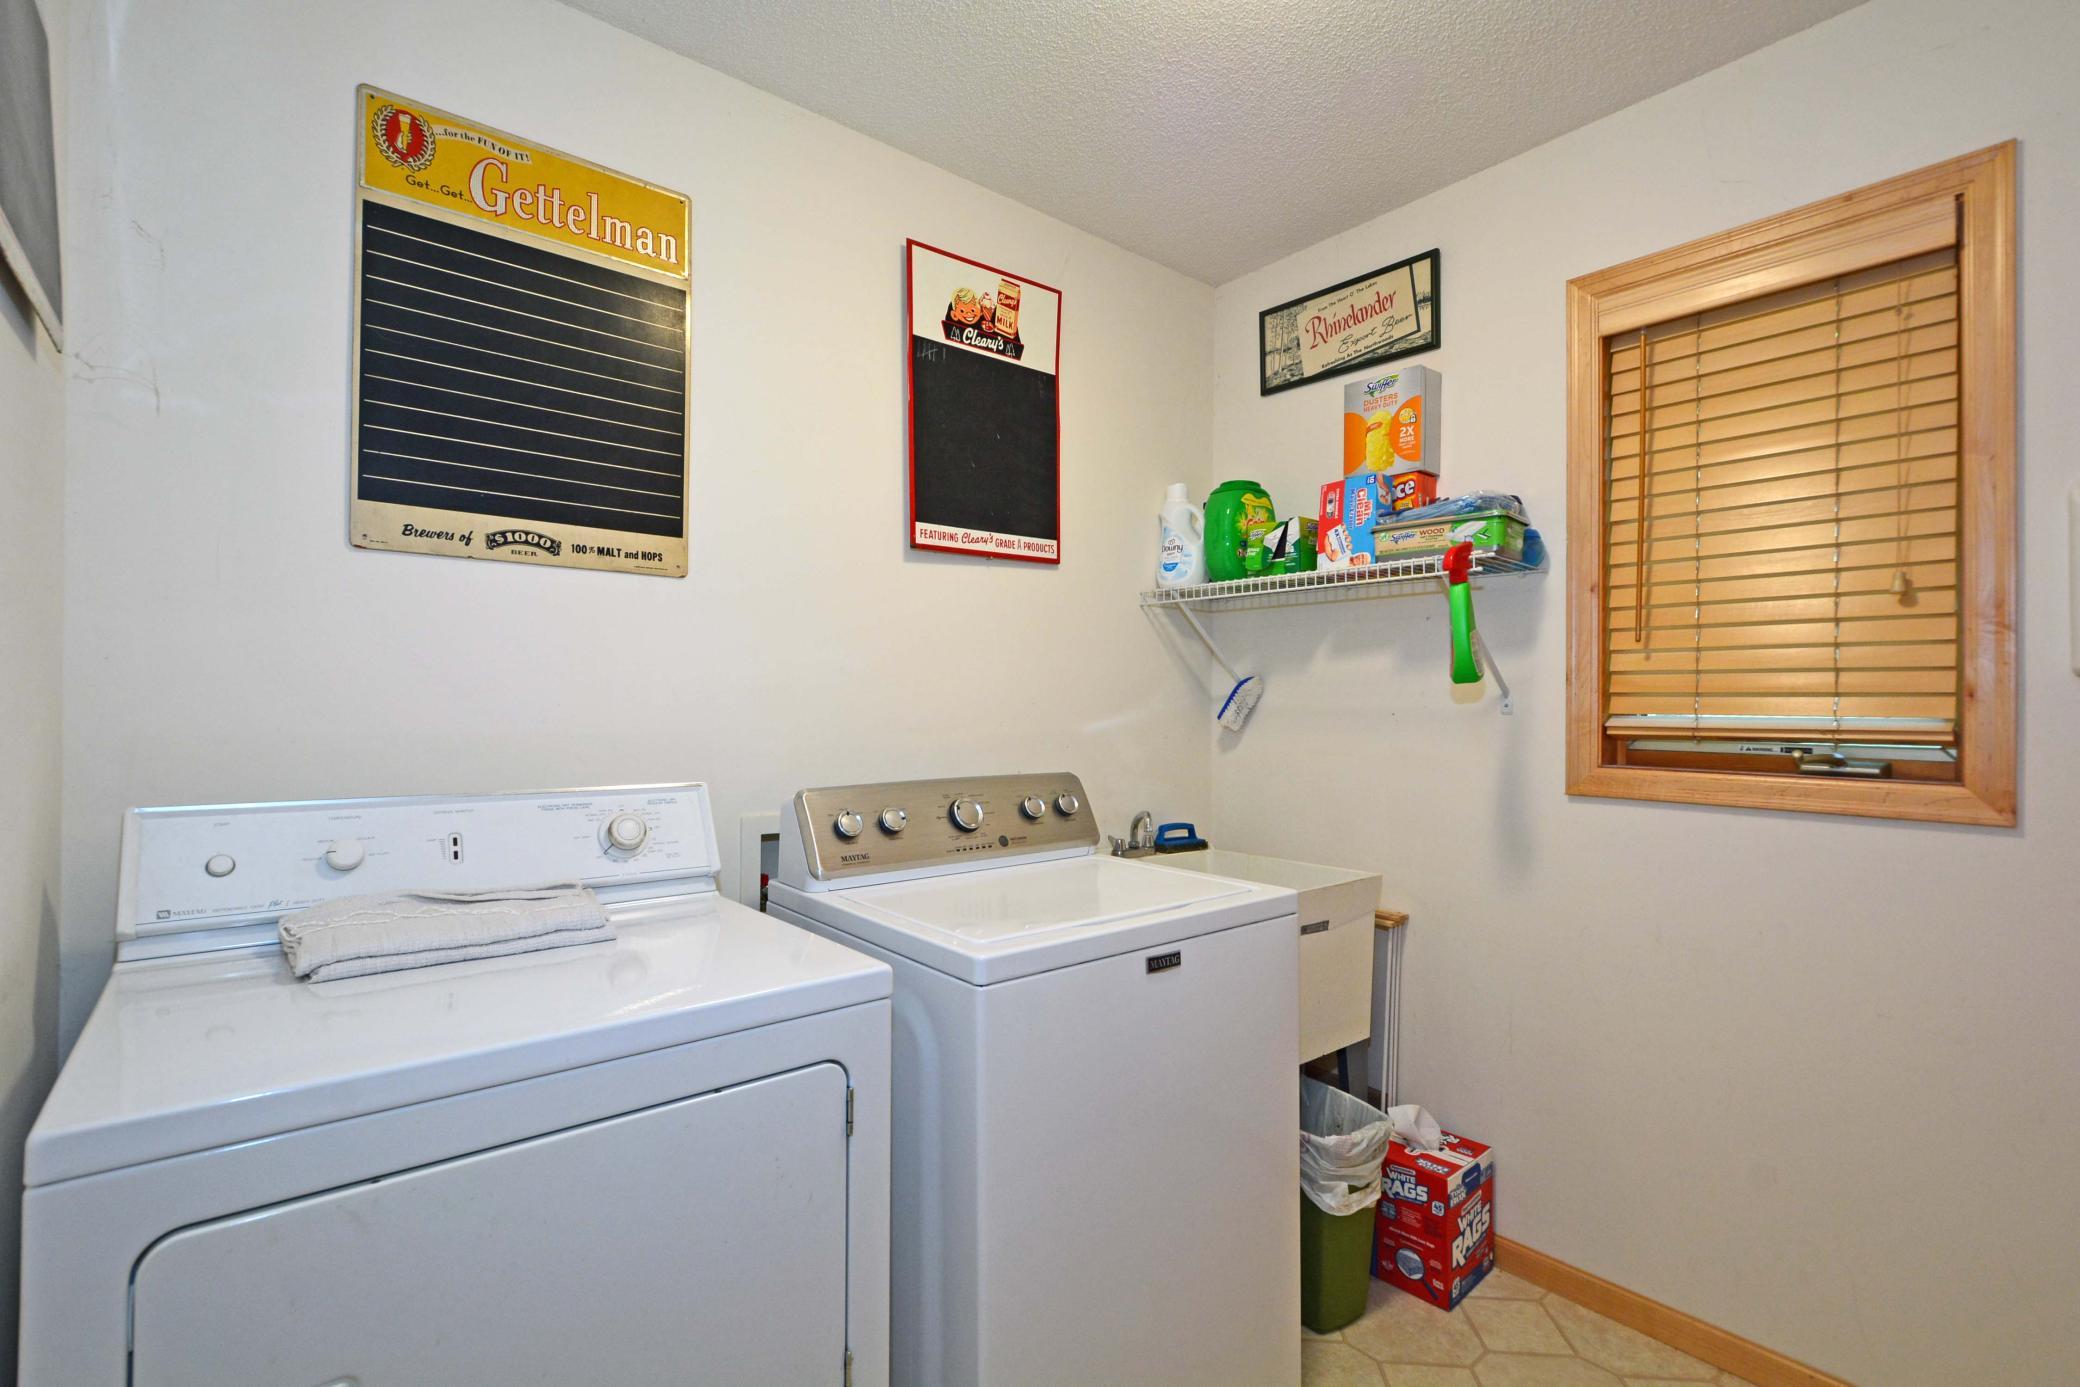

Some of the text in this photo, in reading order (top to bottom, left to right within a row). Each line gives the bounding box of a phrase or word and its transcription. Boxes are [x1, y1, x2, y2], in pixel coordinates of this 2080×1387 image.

[460, 132, 475, 142] the
[477, 136, 498, 151] FUN
[498, 147, 512, 157] OF
[514, 151, 530, 162] IT!
[468, 157, 679, 265] Gettelman
[997, 315, 1013, 330] MILK
[1305, 290, 1397, 350] Rhinelander
[962, 327, 1004, 352] Cleary's
[1338, 315, 1413, 354] Export Beer
[1363, 377, 1399, 394] Swiffer
[1363, 392, 1399, 406] DUSTERS
[1363, 400, 1398, 413] HEAVY DUTY
[1399, 425, 1415, 437] 2X
[1356, 487, 1368, 527] Clean
[401, 524, 474, 547] Brewers of
[494, 531, 552, 548] $1000
[1419, 527, 1445, 536] WOOD
[919, 528, 1055, 554] FEATURING Cleary's GRADE A PRODUCTS
[1161, 544, 1184, 553] Downy
[511, 549, 538, 557] BEER
[597, 546, 622, 558] MALT
[624, 550, 639, 560] and
[641, 551, 663, 562] HOPS
[840, 853, 870, 863] MAYTAG
[1150, 954, 1180, 969] MAYTAG
[1386, 1167, 1416, 1183] WHITE
[1381, 1177, 1428, 1203] RAGS
[1457, 1200, 1482, 1232] WHITE
[1452, 1201, 1491, 1269] RAGS
